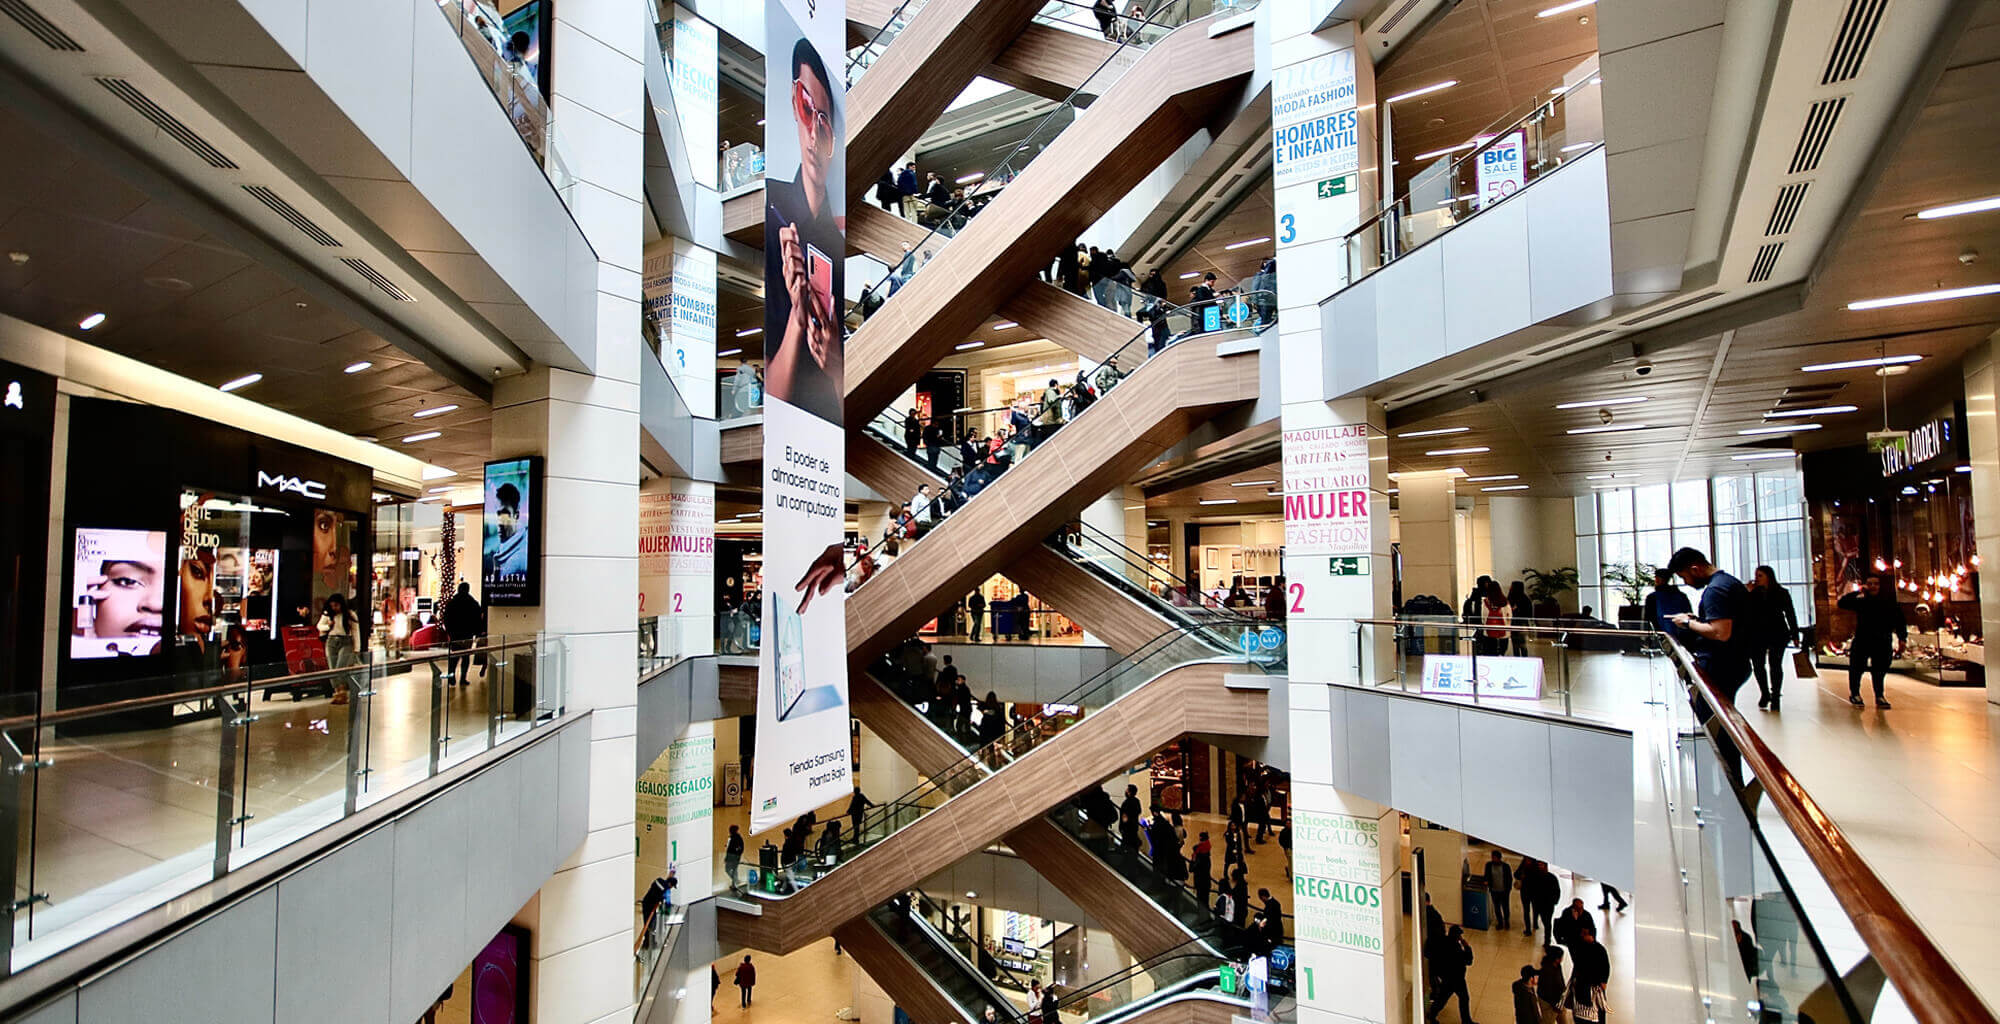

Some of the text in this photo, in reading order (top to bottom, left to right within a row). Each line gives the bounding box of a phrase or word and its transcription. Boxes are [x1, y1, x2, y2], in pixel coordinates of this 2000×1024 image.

[675, 57, 716, 94] TECNO
[1274, 98, 1306, 116] MODA
[1308, 83, 1354, 107] FASHION
[1276, 110, 1357, 147] HOMBRES
[1276, 130, 1357, 163] E INFANTIL
[1484, 148, 1517, 165] BIG
[1484, 162, 1518, 174] SALE
[1280, 213, 1296, 243] 3
[673, 293, 716, 317] HOMBRES
[673, 306, 678, 318] E
[680, 310, 716, 328] INFANTIL
[1208, 315, 1216, 328] 3
[1284, 425, 1366, 442] MAQUILLAJE
[785, 445, 829, 473] El poder de
[1284, 450, 1347, 465] CARTERAS
[771, 467, 840, 497] almacenar como
[1286, 473, 1367, 490] VESTUARIO
[184, 502, 212, 520] ARTE
[776, 495, 837, 518] un computador
[1285, 491, 1368, 521] MUJER
[184, 517, 199, 533] DE
[183, 532, 220, 548] STUDIO
[670, 535, 713, 553] MUJER
[1287, 527, 1369, 545] FASHION
[183, 546, 198, 560] FIX
[674, 592, 682, 612] 2
[1289, 583, 1305, 613] 2
[1438, 662, 1453, 688] BIG
[789, 749, 845, 776] Tienda Samsung
[668, 776, 712, 797] REGALOS
[809, 767, 846, 789] Planta Baja
[1294, 813, 1377, 832] chocolates
[1296, 826, 1379, 848] REGALOS
[671, 840, 677, 861] 1
[1296, 876, 1380, 908] REGALOS
[1338, 931, 1380, 950] JUMBO
[1224, 976, 1230, 990] 1
[1304, 966, 1315, 1001] 1
